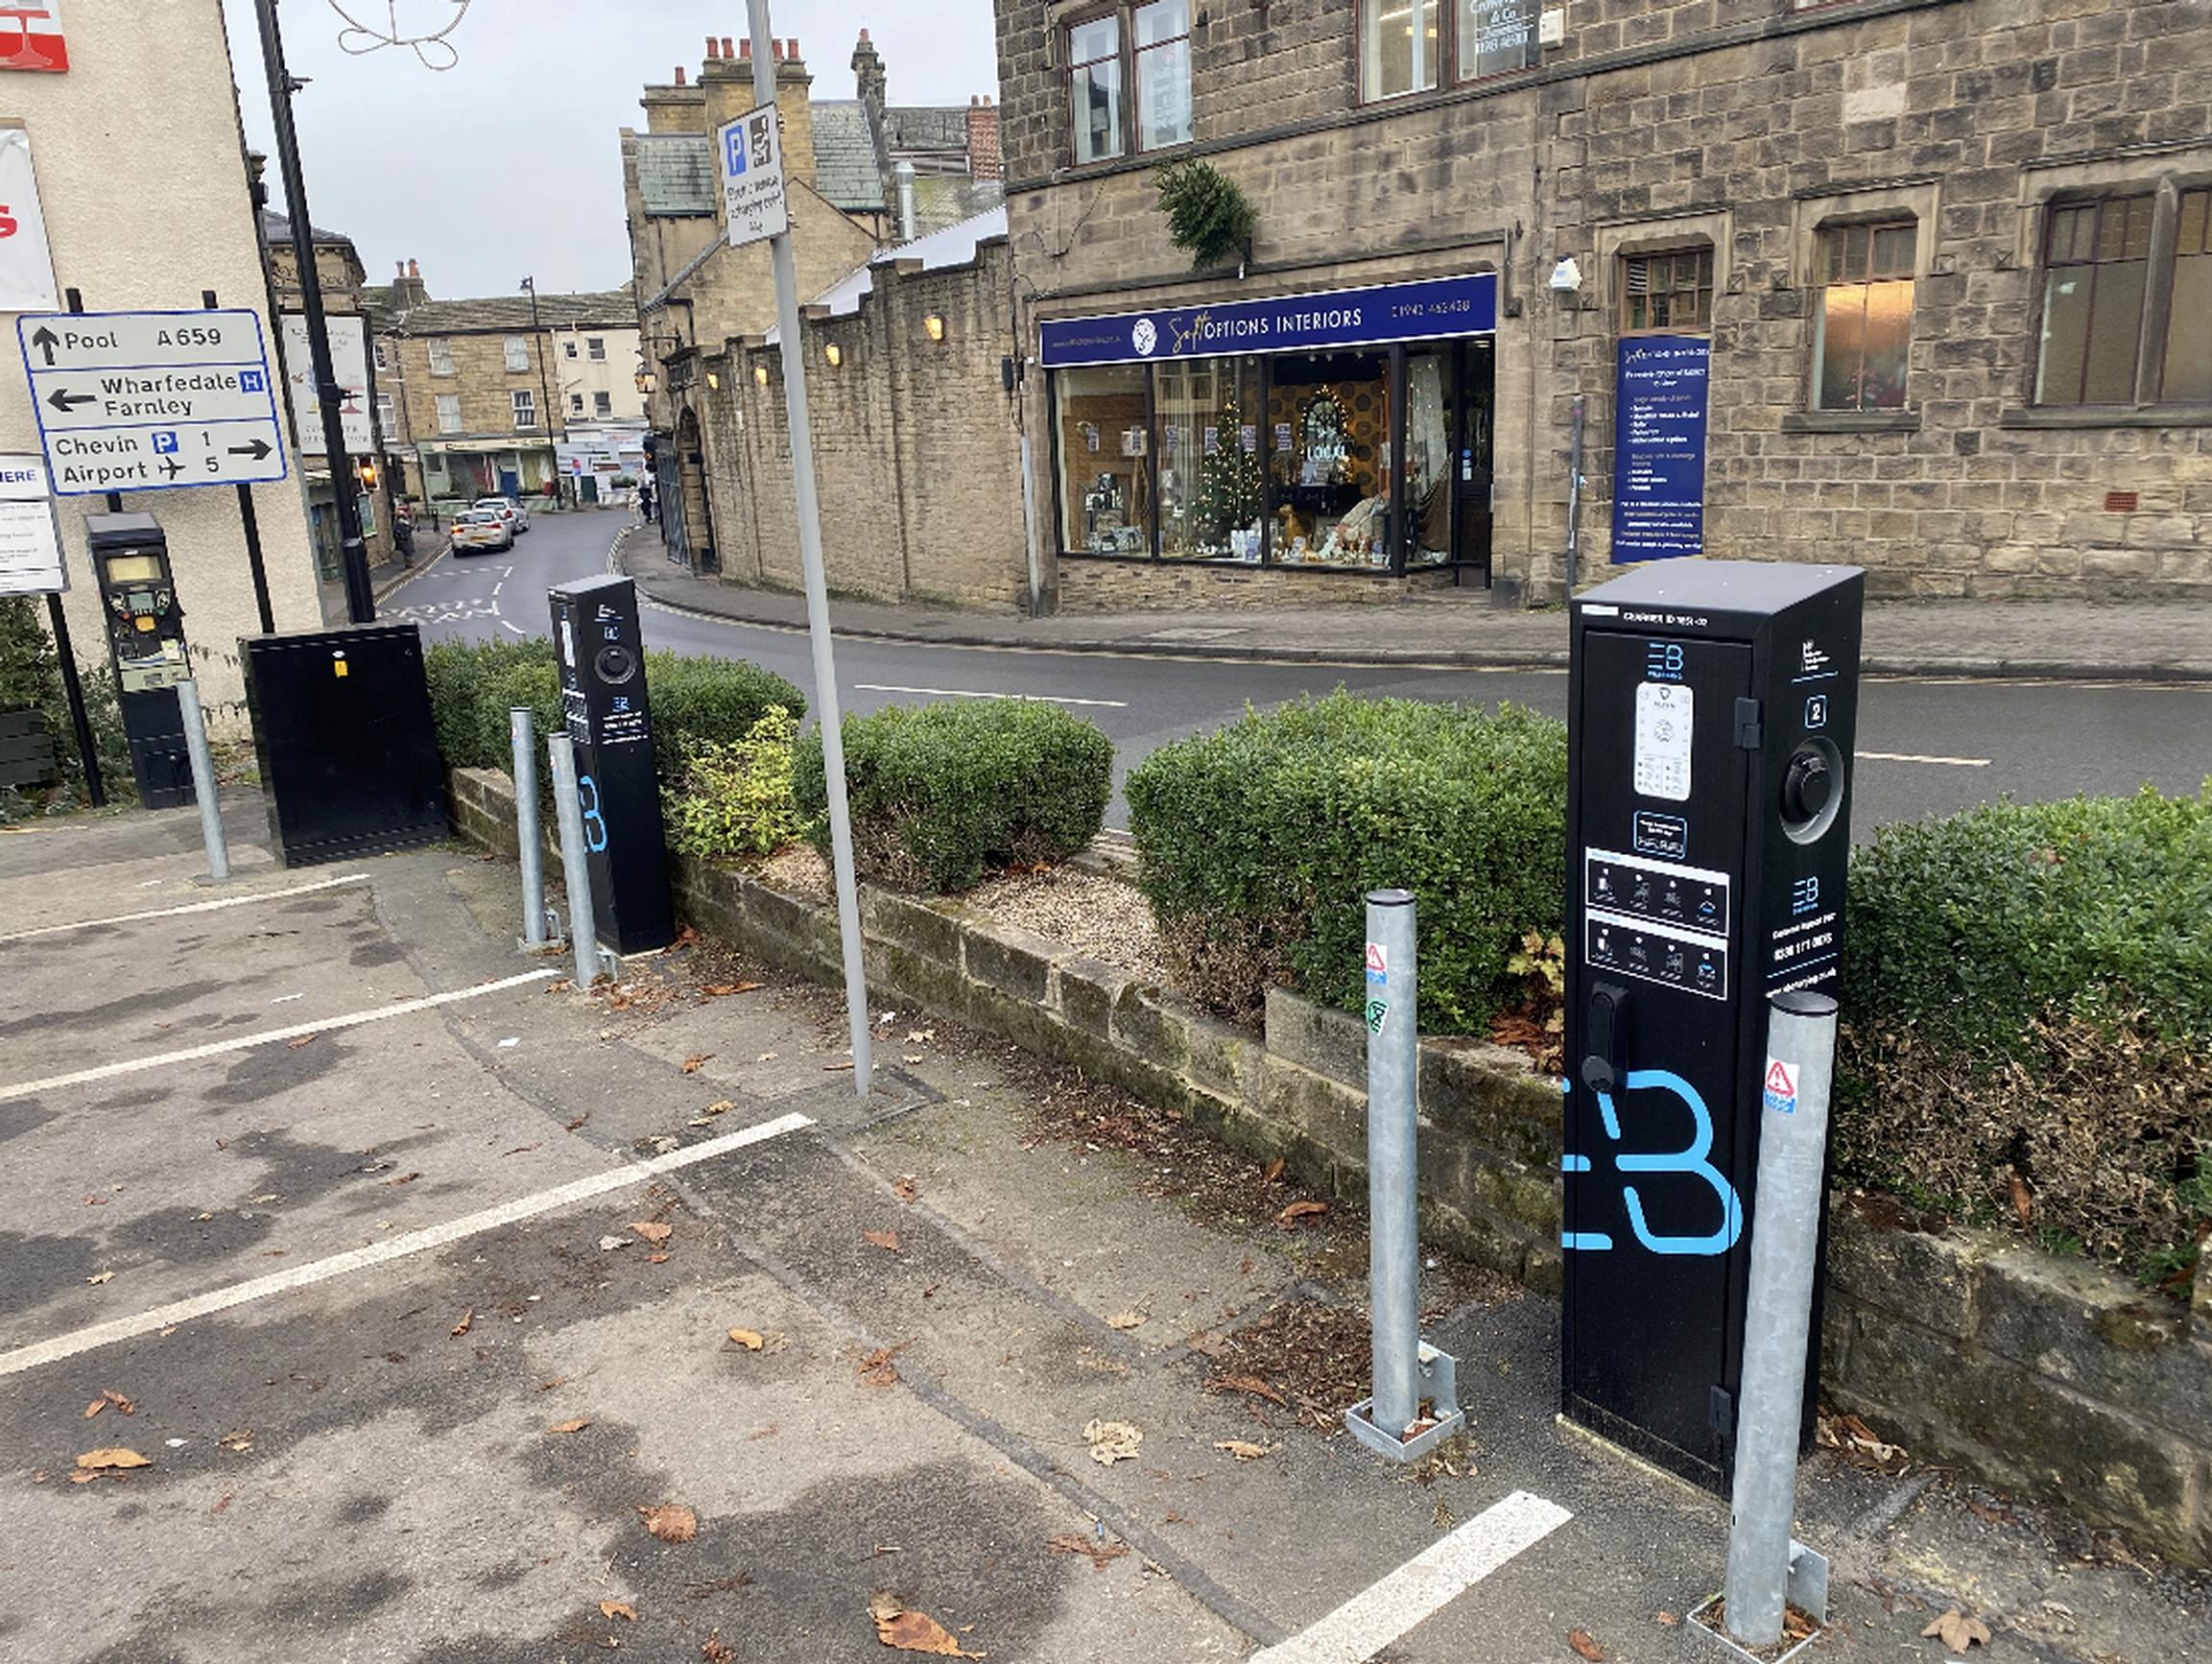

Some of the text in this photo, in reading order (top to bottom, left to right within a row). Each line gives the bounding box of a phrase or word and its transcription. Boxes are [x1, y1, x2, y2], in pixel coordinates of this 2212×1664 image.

[1204, 318, 1269, 339] OPTIONS
[1276, 307, 1362, 333] INTERIORS
[64, 332, 119, 349] Pool
[101, 373, 237, 394] Wharfedale
[105, 399, 192, 416] Farnley
[56, 434, 138, 456] Chevin
[202, 431, 211, 447] 1
[63, 456, 219, 485] Airport 5
[1812, 702, 1821, 720] 2
